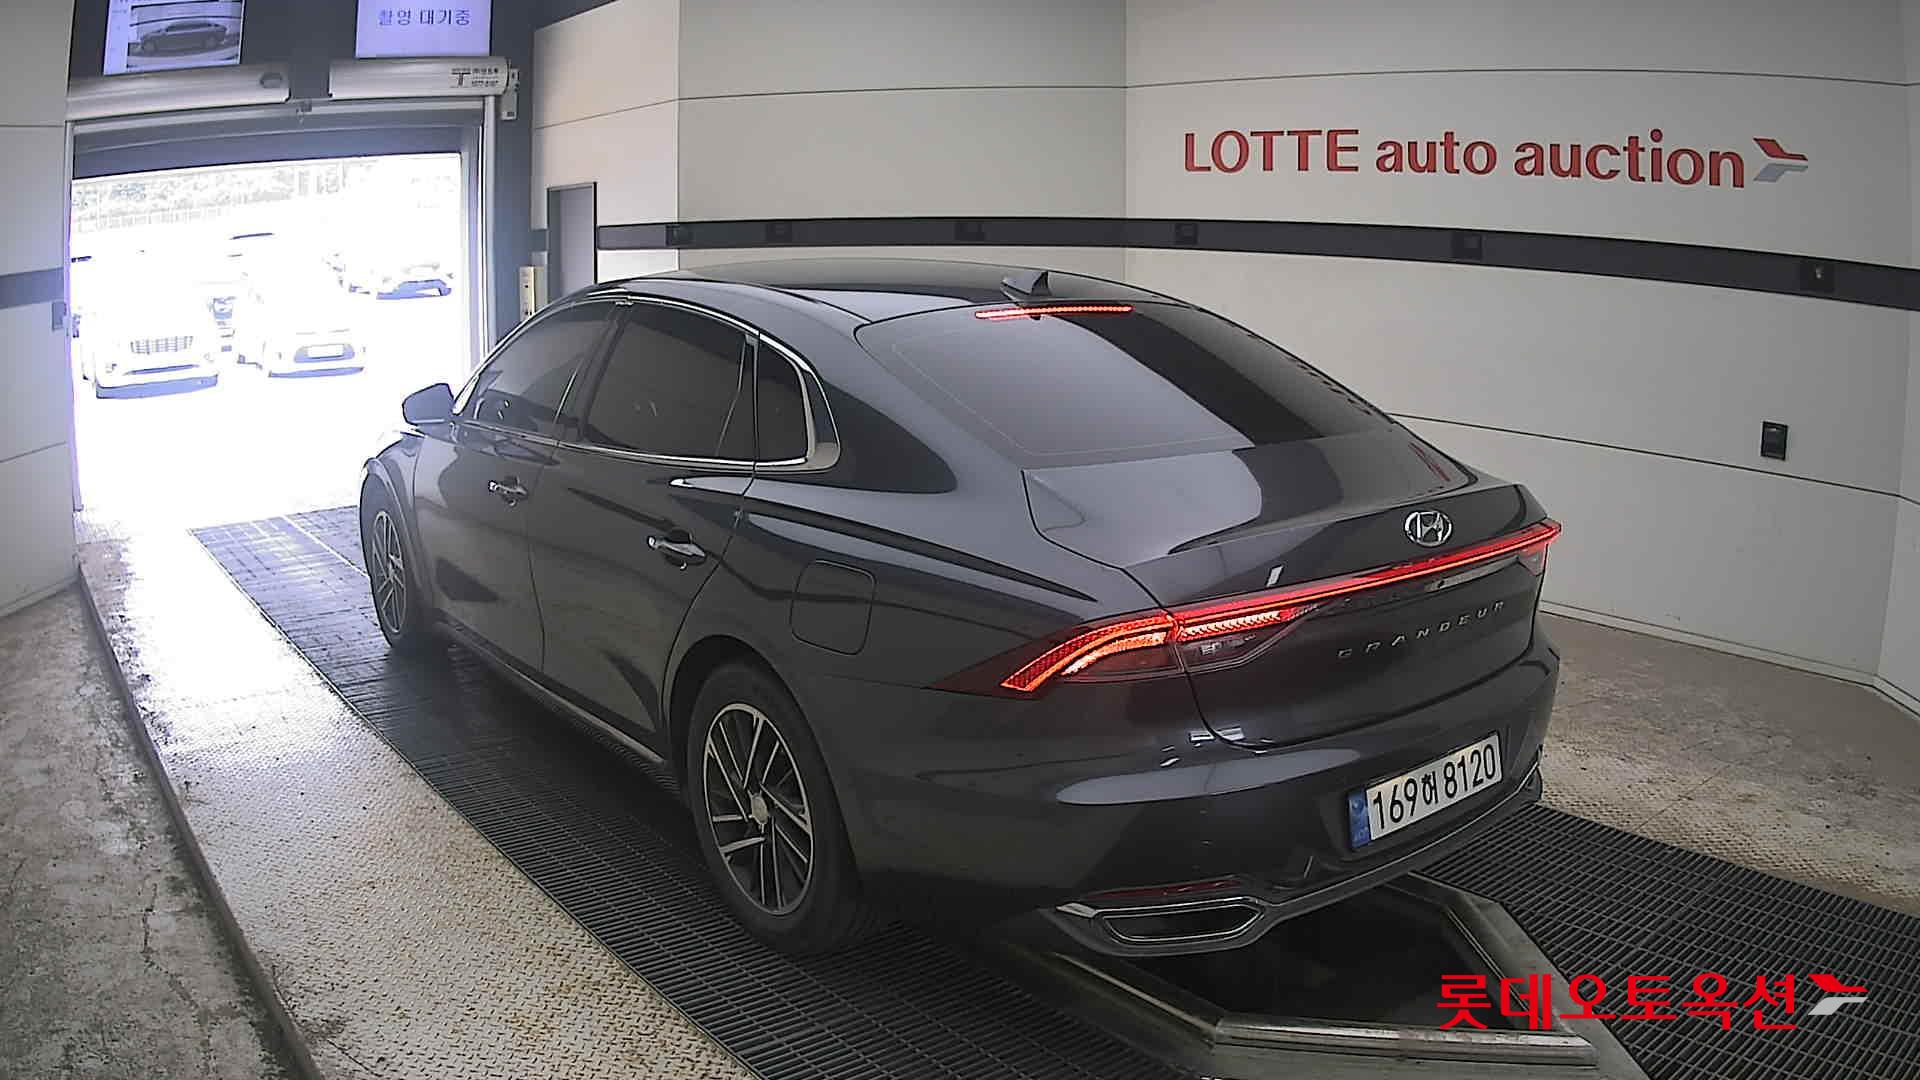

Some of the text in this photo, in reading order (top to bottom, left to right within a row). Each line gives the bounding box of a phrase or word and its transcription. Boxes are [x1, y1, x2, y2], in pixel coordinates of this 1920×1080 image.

[419, 8, 470, 26] 대기중
[1184, 128, 1745, 189] LOTTE auto auction
[1337, 601, 1505, 658] GRANDEUR
[1373, 744, 1496, 830] 169허 8120
